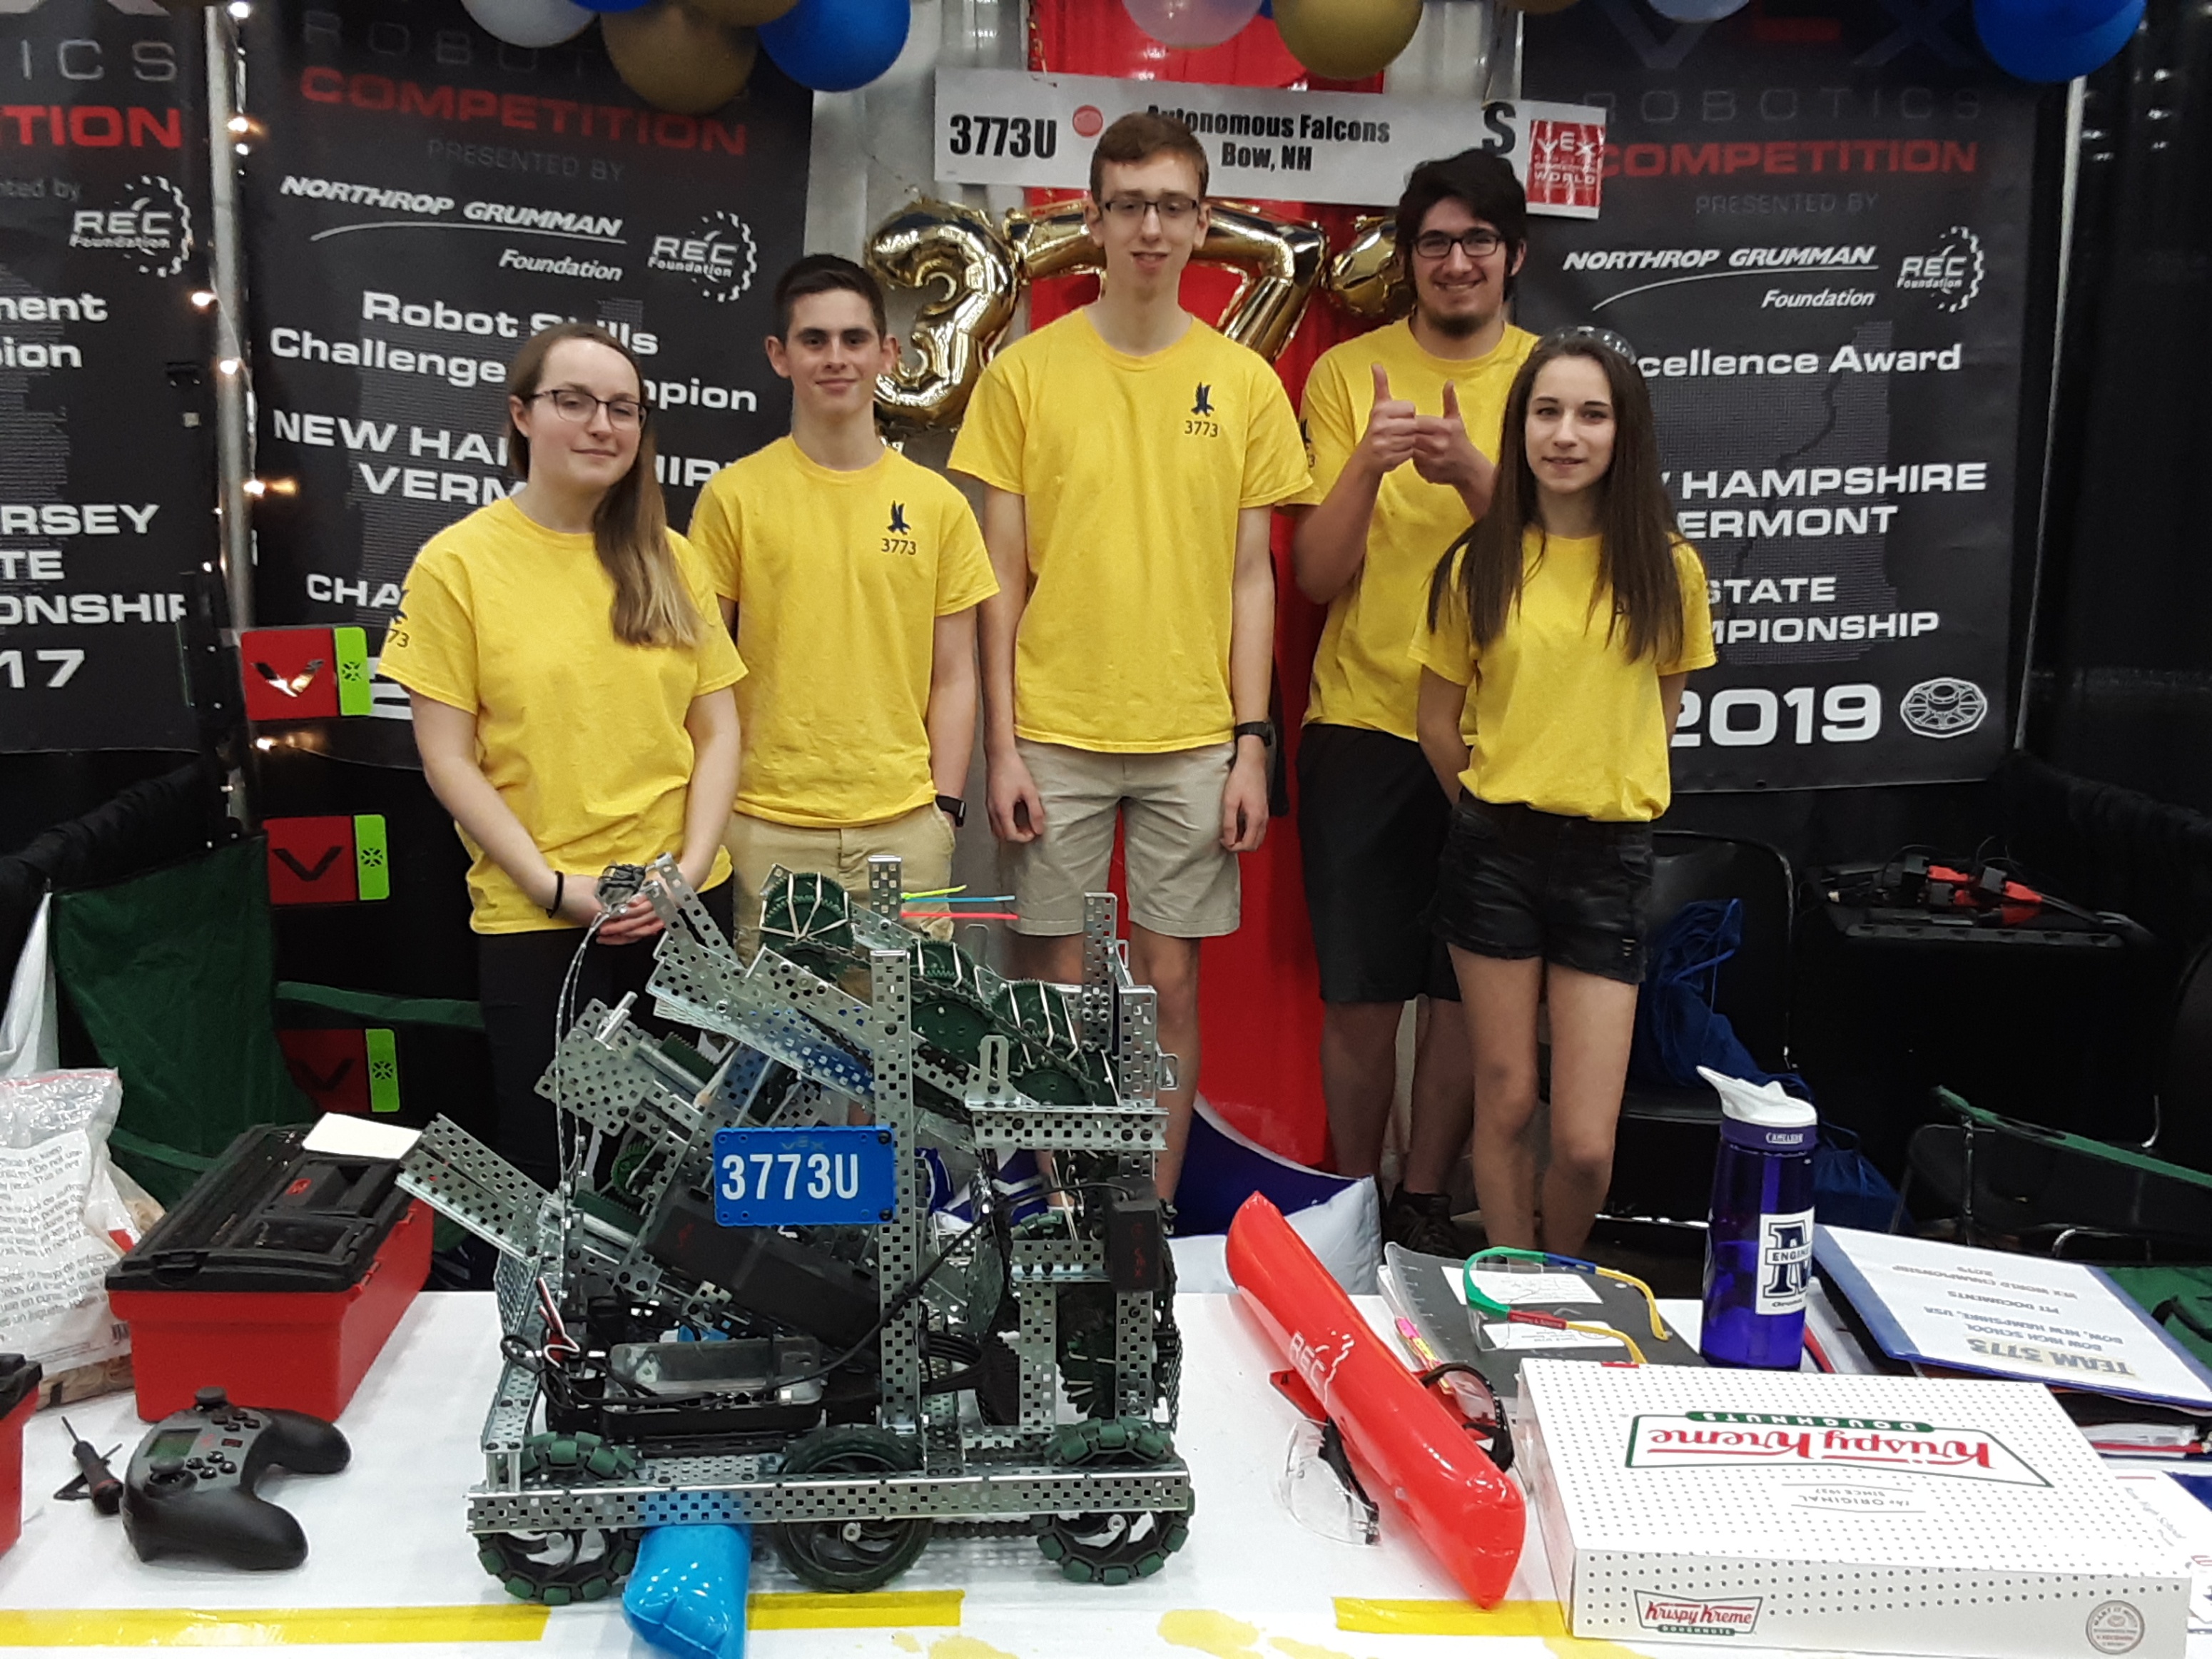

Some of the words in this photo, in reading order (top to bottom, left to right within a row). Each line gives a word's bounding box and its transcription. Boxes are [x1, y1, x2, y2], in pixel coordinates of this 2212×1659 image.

[21, 39, 178, 82] ICS
[300, 66, 747, 156] COMPETITION
[1, 104, 183, 148] TION
[949, 114, 1057, 158] 3773U
[1299, 114, 1391, 143] Falcons
[1482, 101, 1516, 156] S
[428, 139, 580, 176] PRESENTED
[589, 160, 626, 182] BY
[1221, 141, 1277, 172] Bow,
[1281, 145, 1313, 171] NH
[1603, 141, 1978, 177] COMPETITION
[280, 176, 455, 216] NORTHROP
[463, 201, 622, 238] GRUMMAN
[1695, 193, 1835, 214] PRESENTED
[1847, 192, 1880, 213] BY
[73, 211, 172, 235] REC
[499, 248, 623, 282] Foundation
[652, 235, 739, 267] REC
[1563, 249, 1720, 271] NORTHROP
[1728, 245, 1877, 268] GRUMMAN
[647, 255, 733, 278] Foundation
[1901, 255, 1967, 278] REC
[1897, 277, 1963, 289] Foundation
[1760, 288, 1876, 309] Foundation
[362, 290, 519, 338] Robot
[0, 336, 83, 367] ion
[270, 328, 506, 387] Challenge
[1829, 344, 1962, 373] Award
[273, 410, 397, 452] NEW
[1184, 420, 1219, 437] 3773
[1682, 462, 1988, 499] HAMPSHIRE
[881, 537, 916, 555] 3773
[1670, 684, 1881, 747] 2019
[721, 1153, 858, 1201] 3773U
[1924, 1306, 1954, 1316] USA
[1947, 1291, 2035, 1310] DOCUMENTS
[1965, 1324, 2024, 1339] SCHOOL
[2027, 1333, 2064, 1346] HIGH
[2049, 1326, 2081, 1338] NEW
[2067, 1339, 2103, 1352] BOW
[2048, 1351, 2136, 1378] TEAM
[1702, 1413, 1917, 1431] DOUGHNUTS
[1647, 1429, 1816, 1461] Kreme
[1822, 1429, 1996, 1468] Krispy
[1797, 1495, 1885, 1506] ORIGINAL
[1645, 1600, 1701, 1625] Krispy
[1699, 1603, 1755, 1625] Kreme
